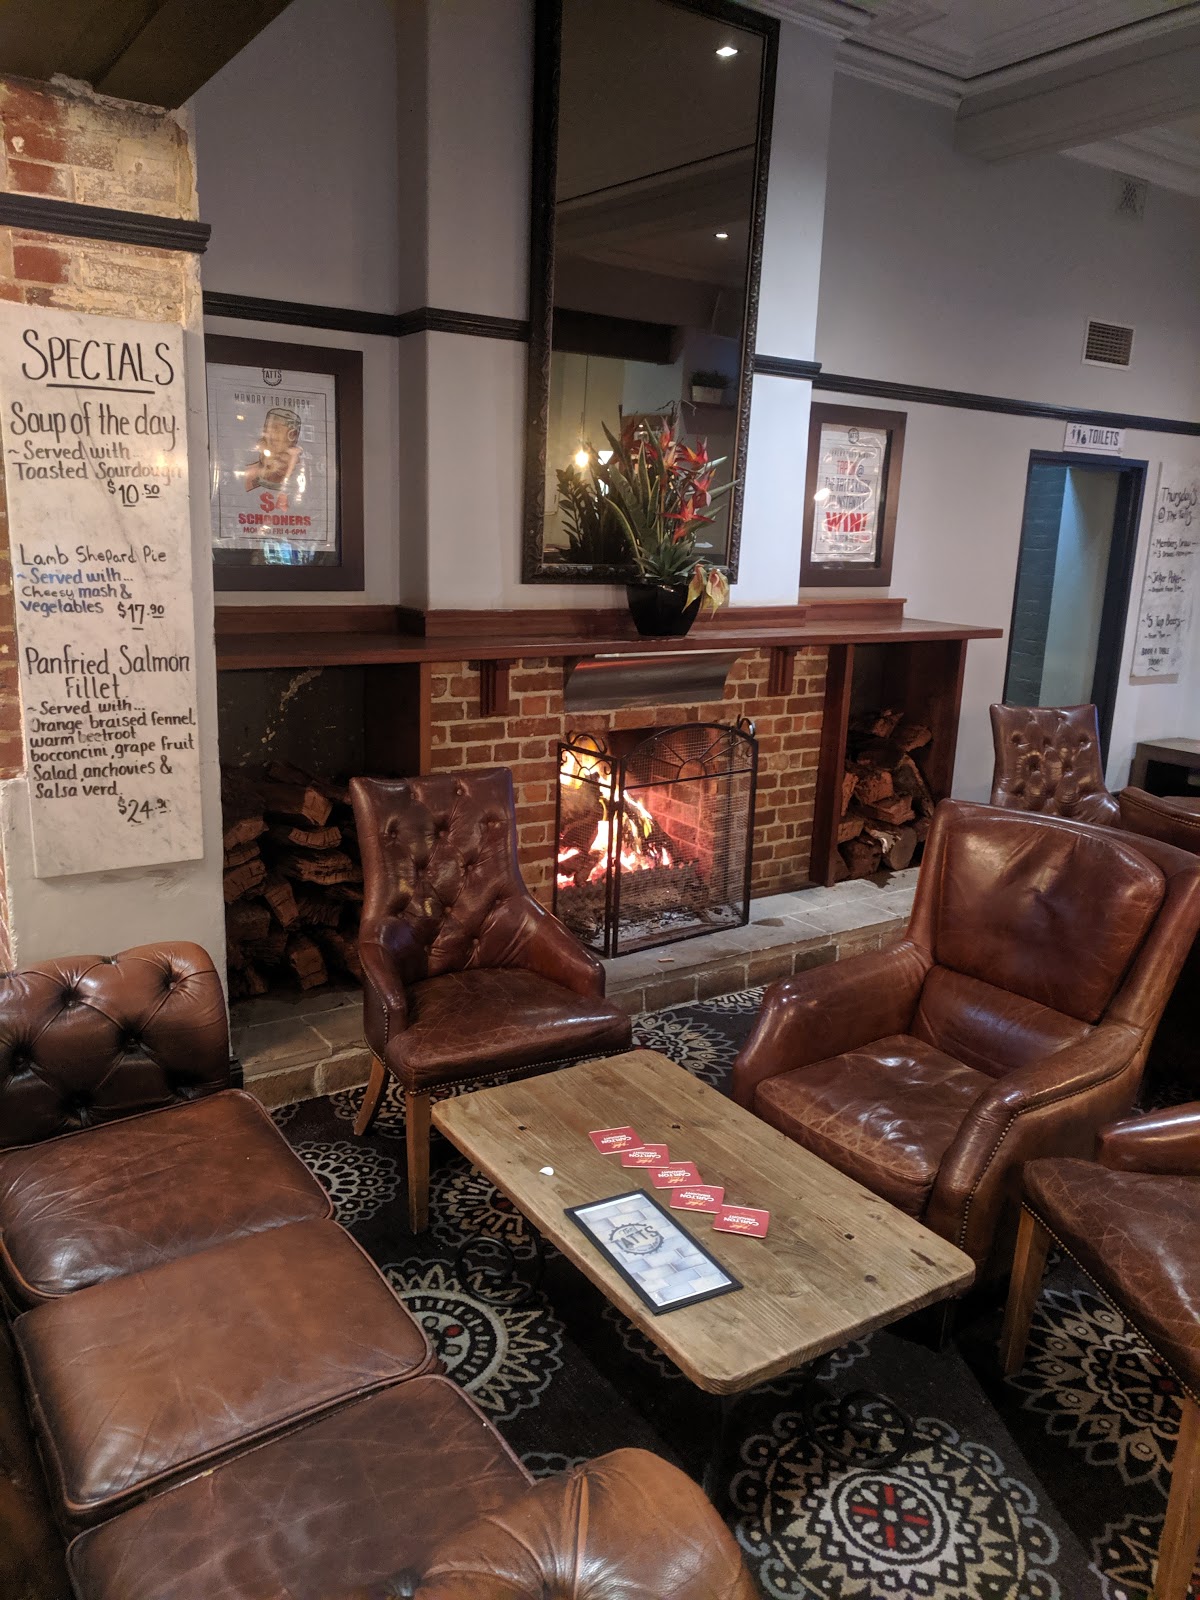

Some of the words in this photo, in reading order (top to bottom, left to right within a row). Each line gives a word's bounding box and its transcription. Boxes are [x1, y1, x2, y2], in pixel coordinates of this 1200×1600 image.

[22, 329, 174, 386] SPECIALS
[234, 392, 266, 405] MONDAY
[270, 396, 280, 406] TO
[283, 397, 311, 409] FRIDAY
[11, 401, 66, 443] Soup
[71, 401, 91, 436] of
[99, 403, 130, 435] the
[1088, 429, 1120, 446] TOILETS
[12, 462, 88, 480] Toasted
[98, 461, 182, 486] Sourdough
[107, 478, 160, 507] $10.50
[238, 513, 311, 527] SCHOONERS
[825, 512, 868, 532] WIN!
[20, 544, 69, 566] Lamb
[143, 545, 168, 563] Pie
[22, 586, 74, 601] Cheesy
[78, 584, 118, 598] mash
[120, 583, 133, 600] &
[20, 600, 104, 618] vegetables
[117, 603, 165, 630] $17.90
[25, 644, 109, 676] Panfried
[119, 645, 190, 675] Salmon
[65, 675, 121, 700] Fillet
[89, 711, 148, 730] braised
[30, 734, 75, 748] warm
[78, 727, 136, 744] beetroot
[161, 733, 195, 751] fruit
[160, 754, 173, 775] &
[35, 781, 78, 799] Salsa
[601, 1136, 632, 1144] CARLTON
[680, 1193, 714, 1202] CARLTON
[723, 1216, 760, 1227] CARLTON
[611, 1225, 658, 1249] TATTS
